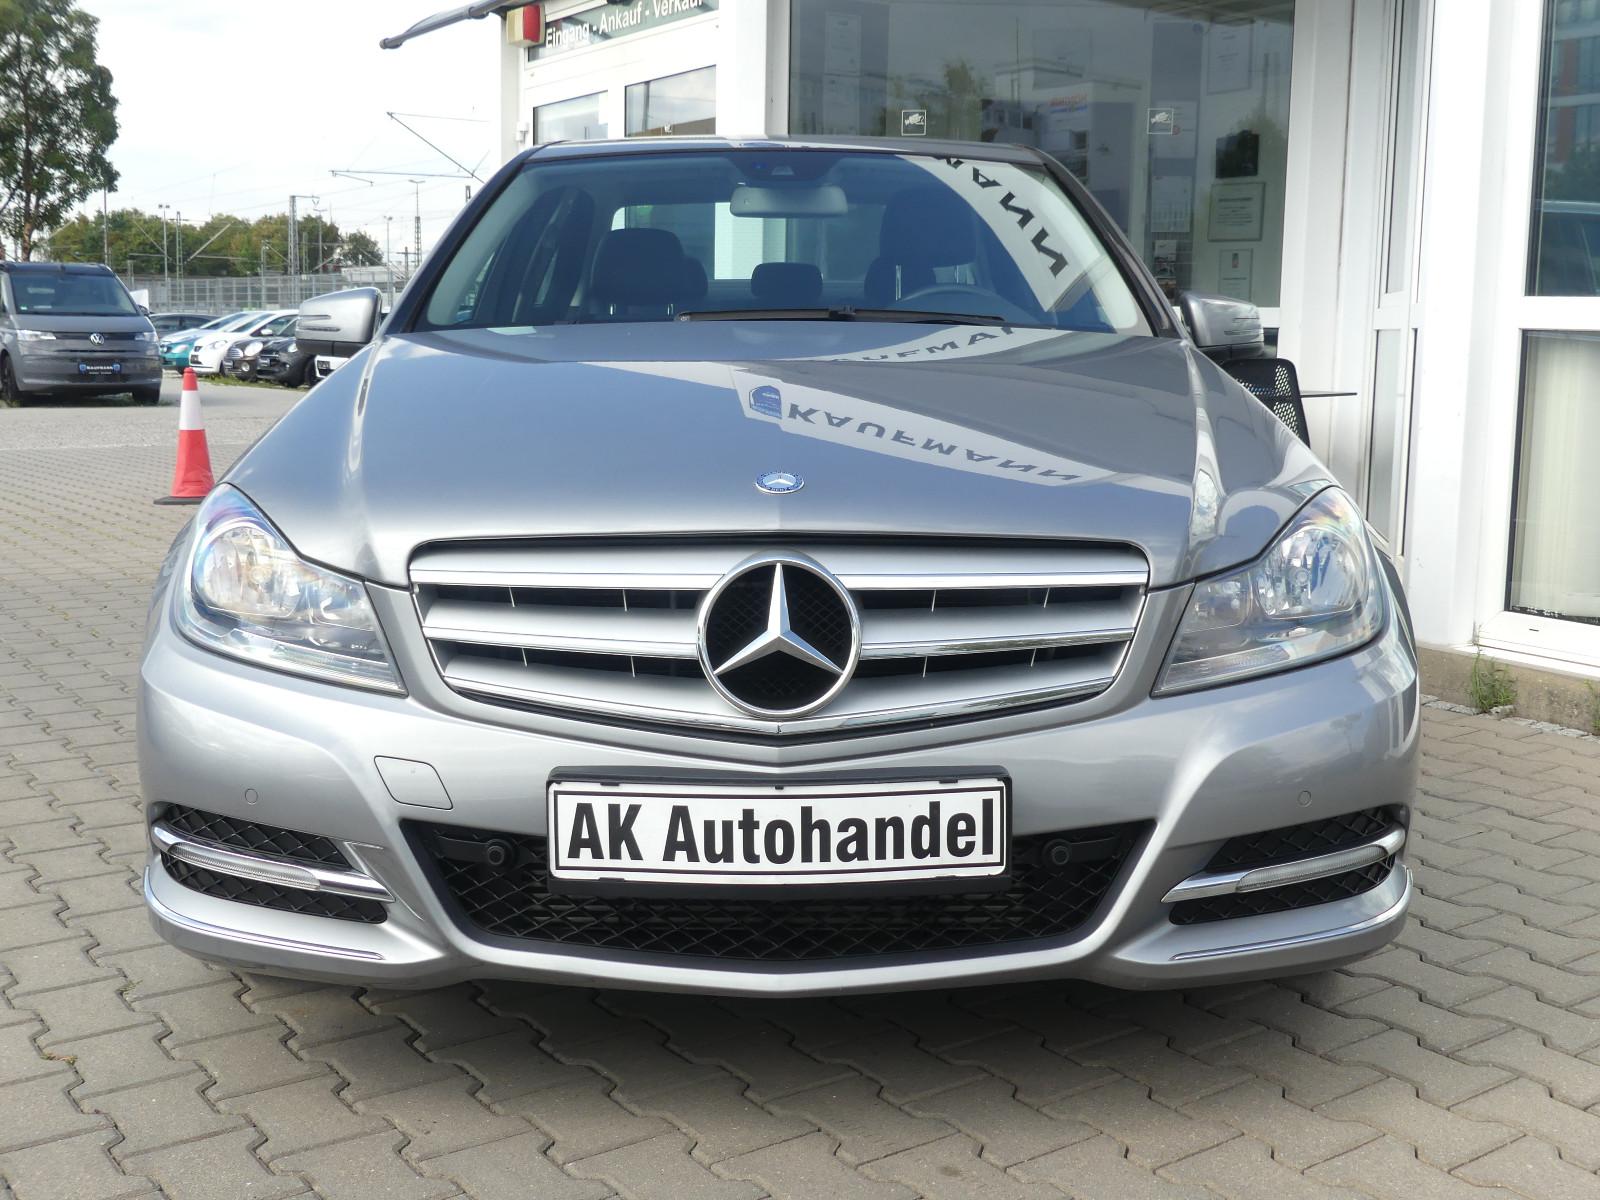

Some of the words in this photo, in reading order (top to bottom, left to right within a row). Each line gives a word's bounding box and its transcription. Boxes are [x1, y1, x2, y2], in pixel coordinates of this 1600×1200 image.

[545, 22, 590, 48] Eingang
[599, 3, 643, 34] Ankauf
[652, 0, 704, 18] Verkau
[567, 802, 643, 861] AK
[662, 798, 994, 865] Autohandel
